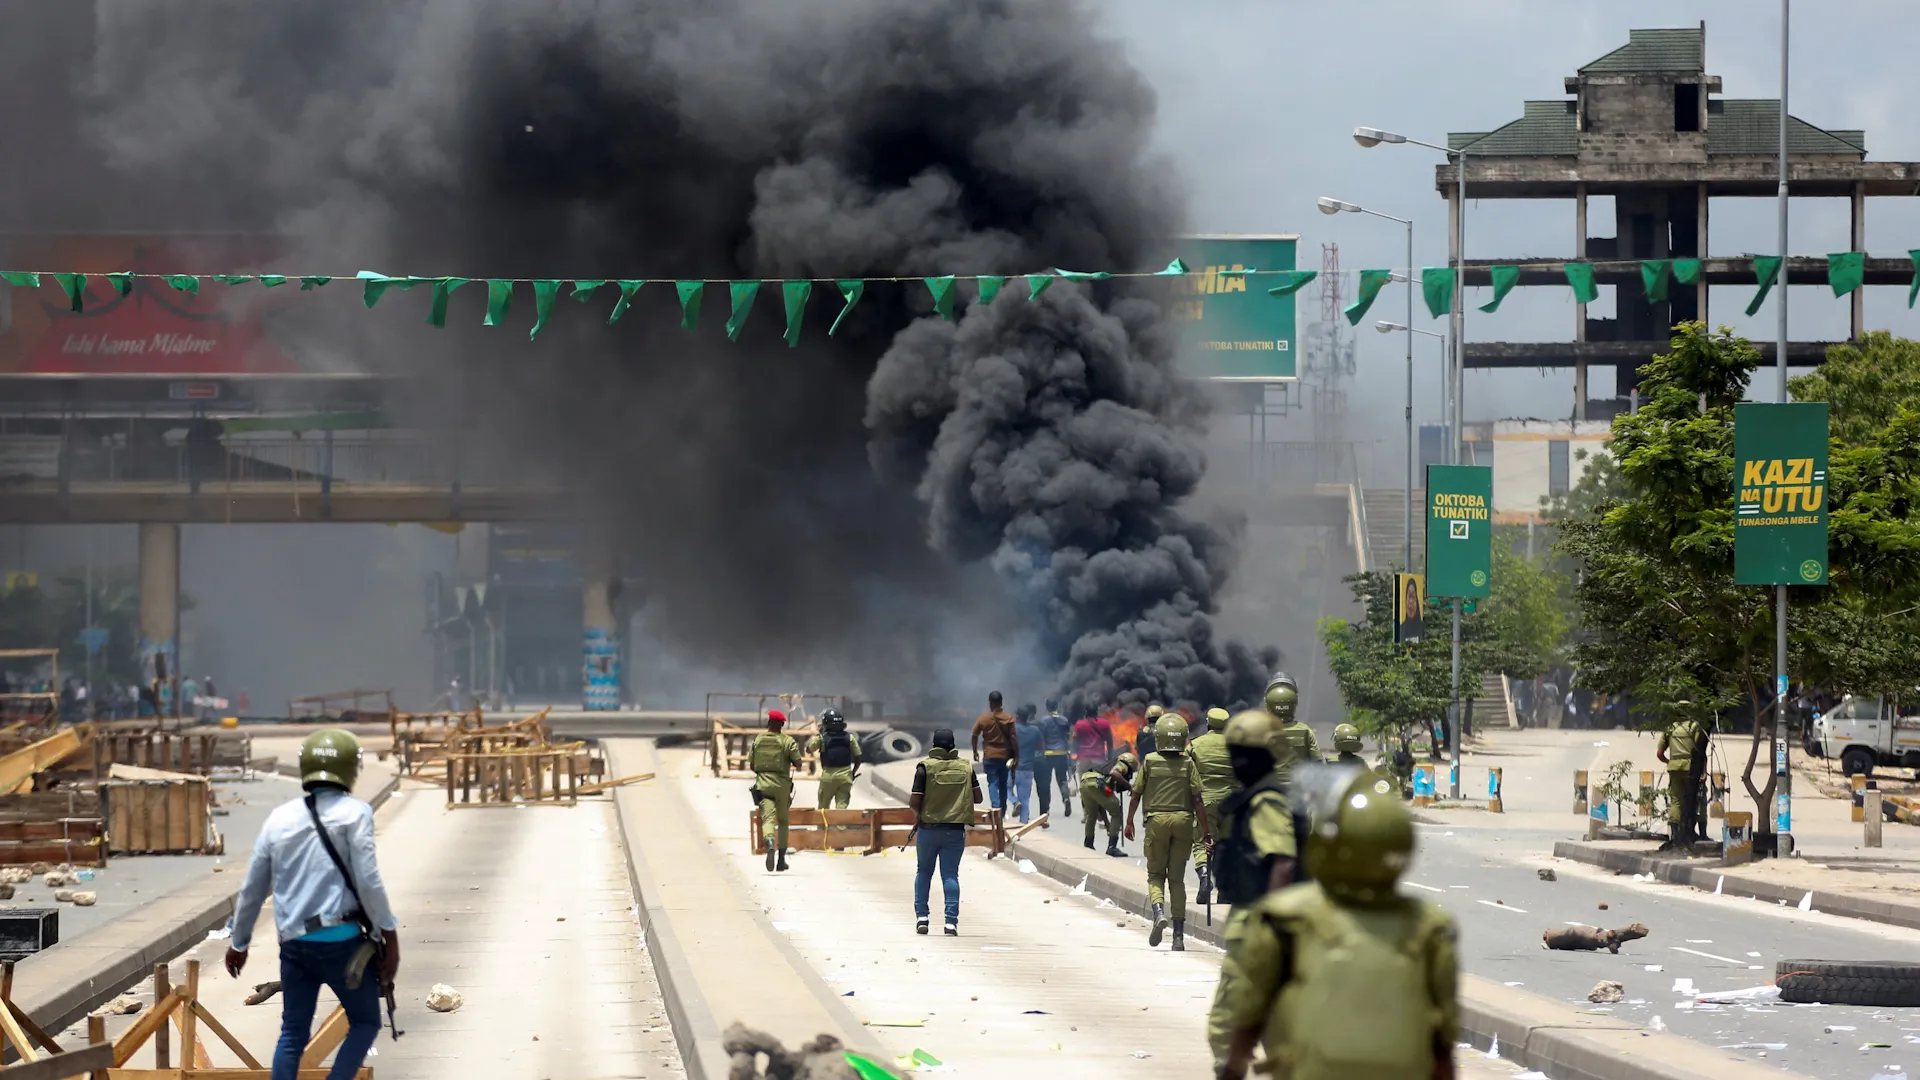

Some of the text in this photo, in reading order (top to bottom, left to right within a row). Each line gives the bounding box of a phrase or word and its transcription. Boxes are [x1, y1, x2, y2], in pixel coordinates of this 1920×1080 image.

[1198, 341, 1274, 351] KTOBA TUNATIKI
[1742, 458, 1814, 486] KAZI
[1435, 493, 1485, 508] OKTOBA
[1740, 485, 1823, 514] NA UTU
[1432, 506, 1488, 520] TUNATIKI
[1738, 515, 1819, 527] TUNASONGA MBELE
[312, 747, 338, 758] POLICE
